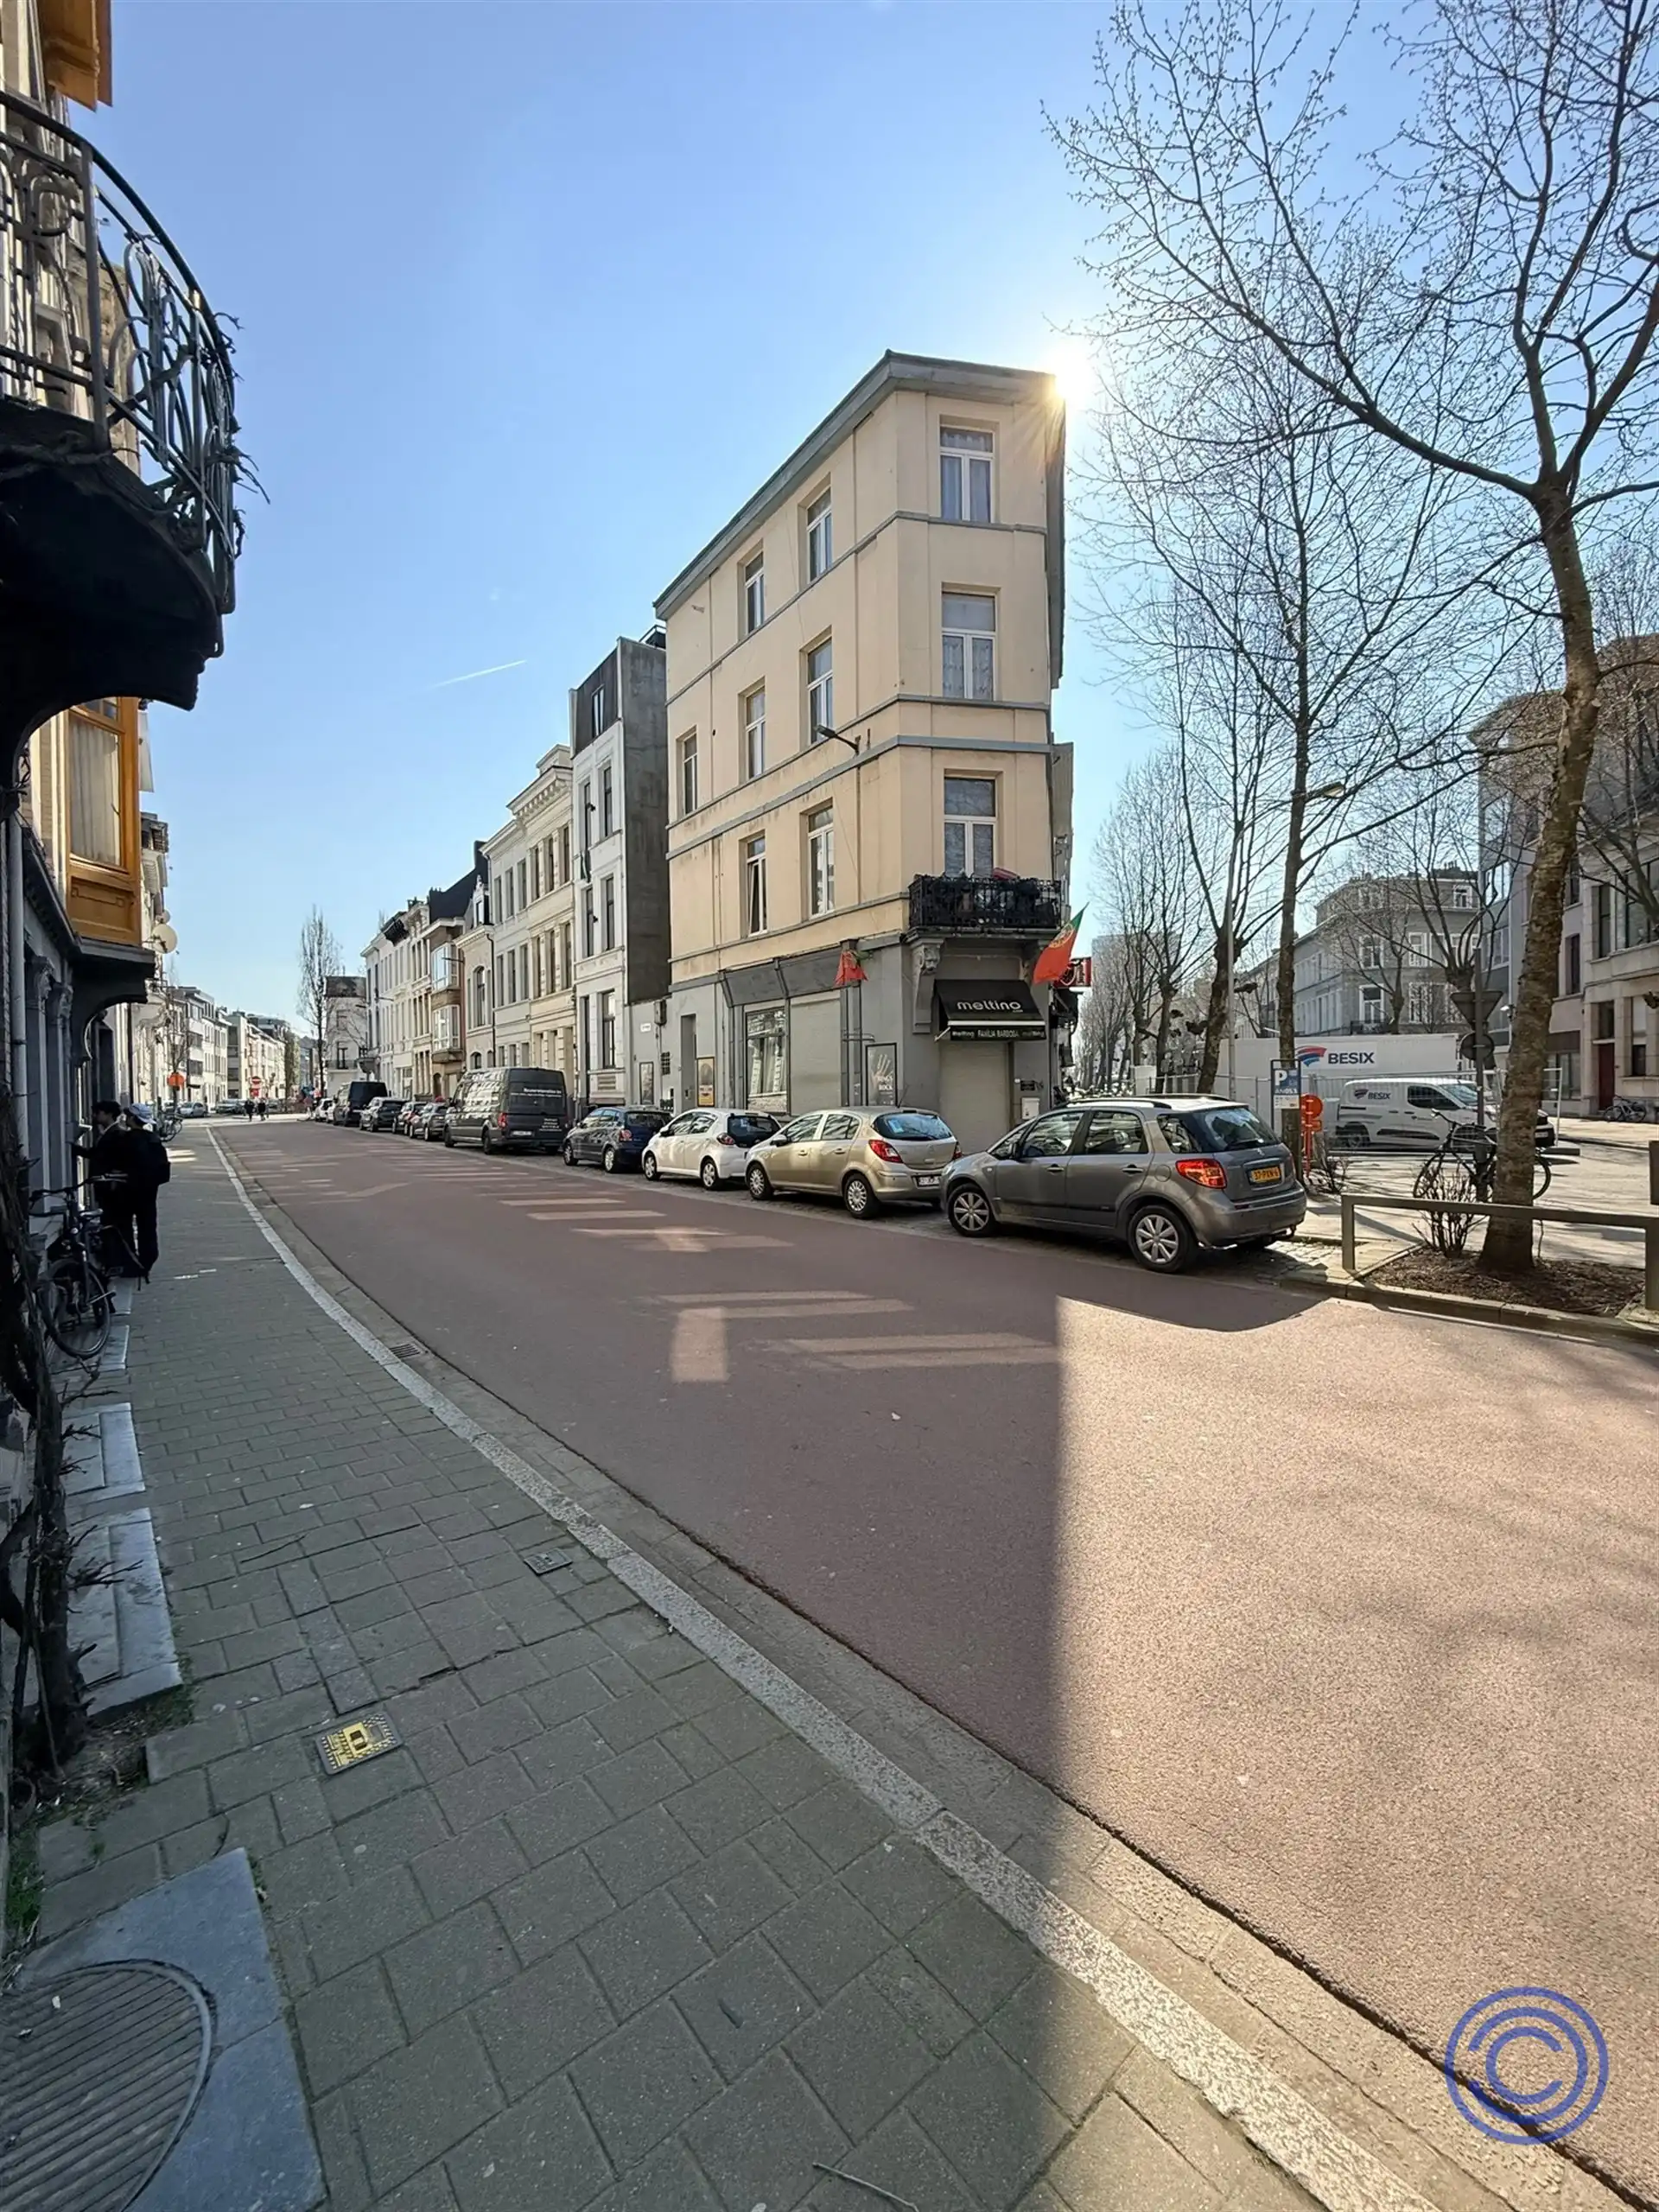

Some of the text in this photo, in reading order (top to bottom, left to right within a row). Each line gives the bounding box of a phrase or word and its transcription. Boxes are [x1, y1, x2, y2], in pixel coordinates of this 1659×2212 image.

[957, 1000, 1021, 1010] meltino
[1328, 1052, 1375, 1065] BESIX
[1274, 1070, 1287, 1086] P
[1368, 1091, 1391, 1100] BESIX
